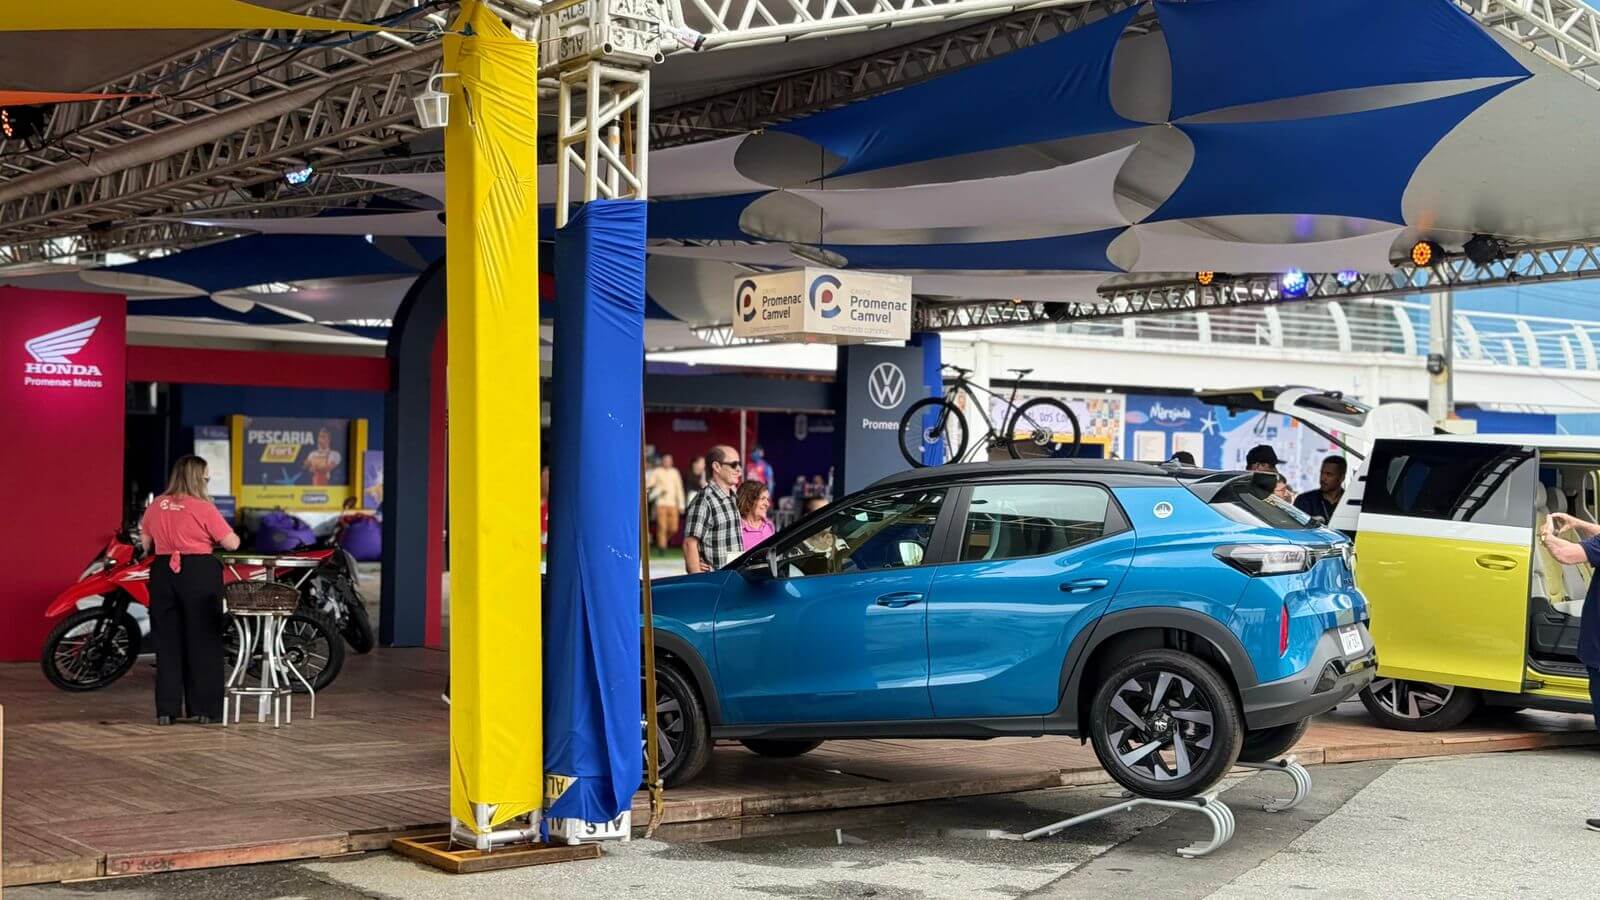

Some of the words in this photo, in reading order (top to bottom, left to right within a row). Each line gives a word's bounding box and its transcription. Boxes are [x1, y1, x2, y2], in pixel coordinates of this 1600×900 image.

[762, 294, 802, 308] Promenac
[850, 295, 908, 311] Promenac
[762, 306, 791, 320] Camvel
[850, 309, 892, 323] Camvel
[25, 362, 103, 376] HONDA
[24, 377, 72, 387] Promenac
[73, 378, 103, 388] Motos
[862, 418, 909, 431] Promen
[248, 430, 315, 445] PESCARIA
